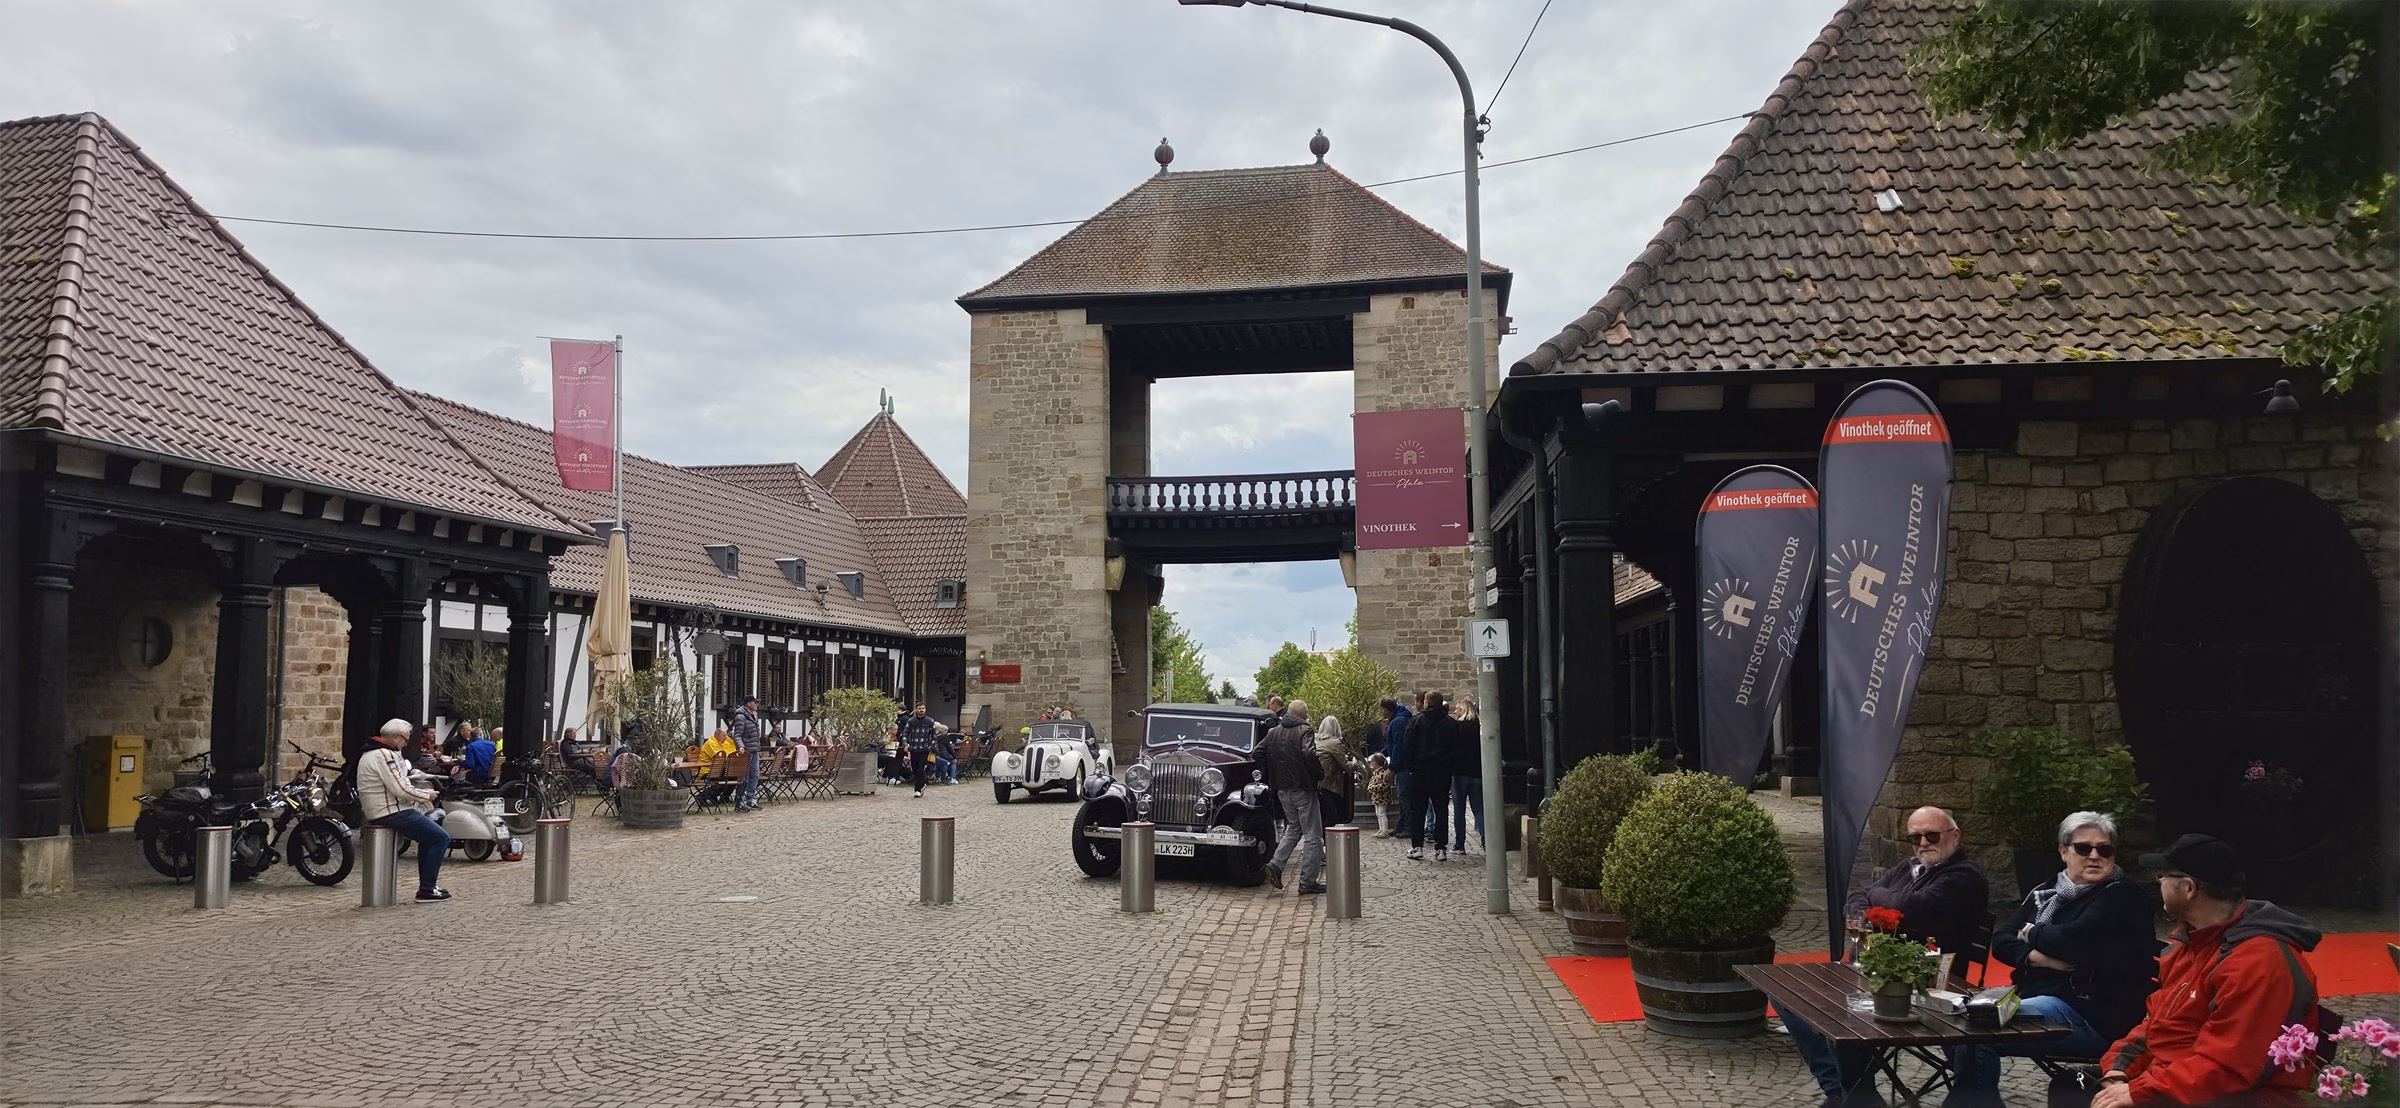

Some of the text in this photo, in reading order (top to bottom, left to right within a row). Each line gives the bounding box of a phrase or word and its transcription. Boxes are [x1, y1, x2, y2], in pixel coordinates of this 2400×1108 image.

[1839, 419, 1932, 440] Vinothek geöffnet
[1366, 466, 1454, 478] DEUTSCHES WEINTOR
[1716, 492, 1807, 507] Vinothek geöffnet
[1362, 522, 1417, 533] VINOTHEK
[1860, 483, 1924, 718] DEUTSCHES WEINTOR
[1735, 535, 1800, 706] DEUTSCHES WEINTOR
[1907, 578, 1938, 657] Pfalz
[1777, 602, 1803, 659] Pfalz
[1160, 844, 1193, 855] LK 223H
